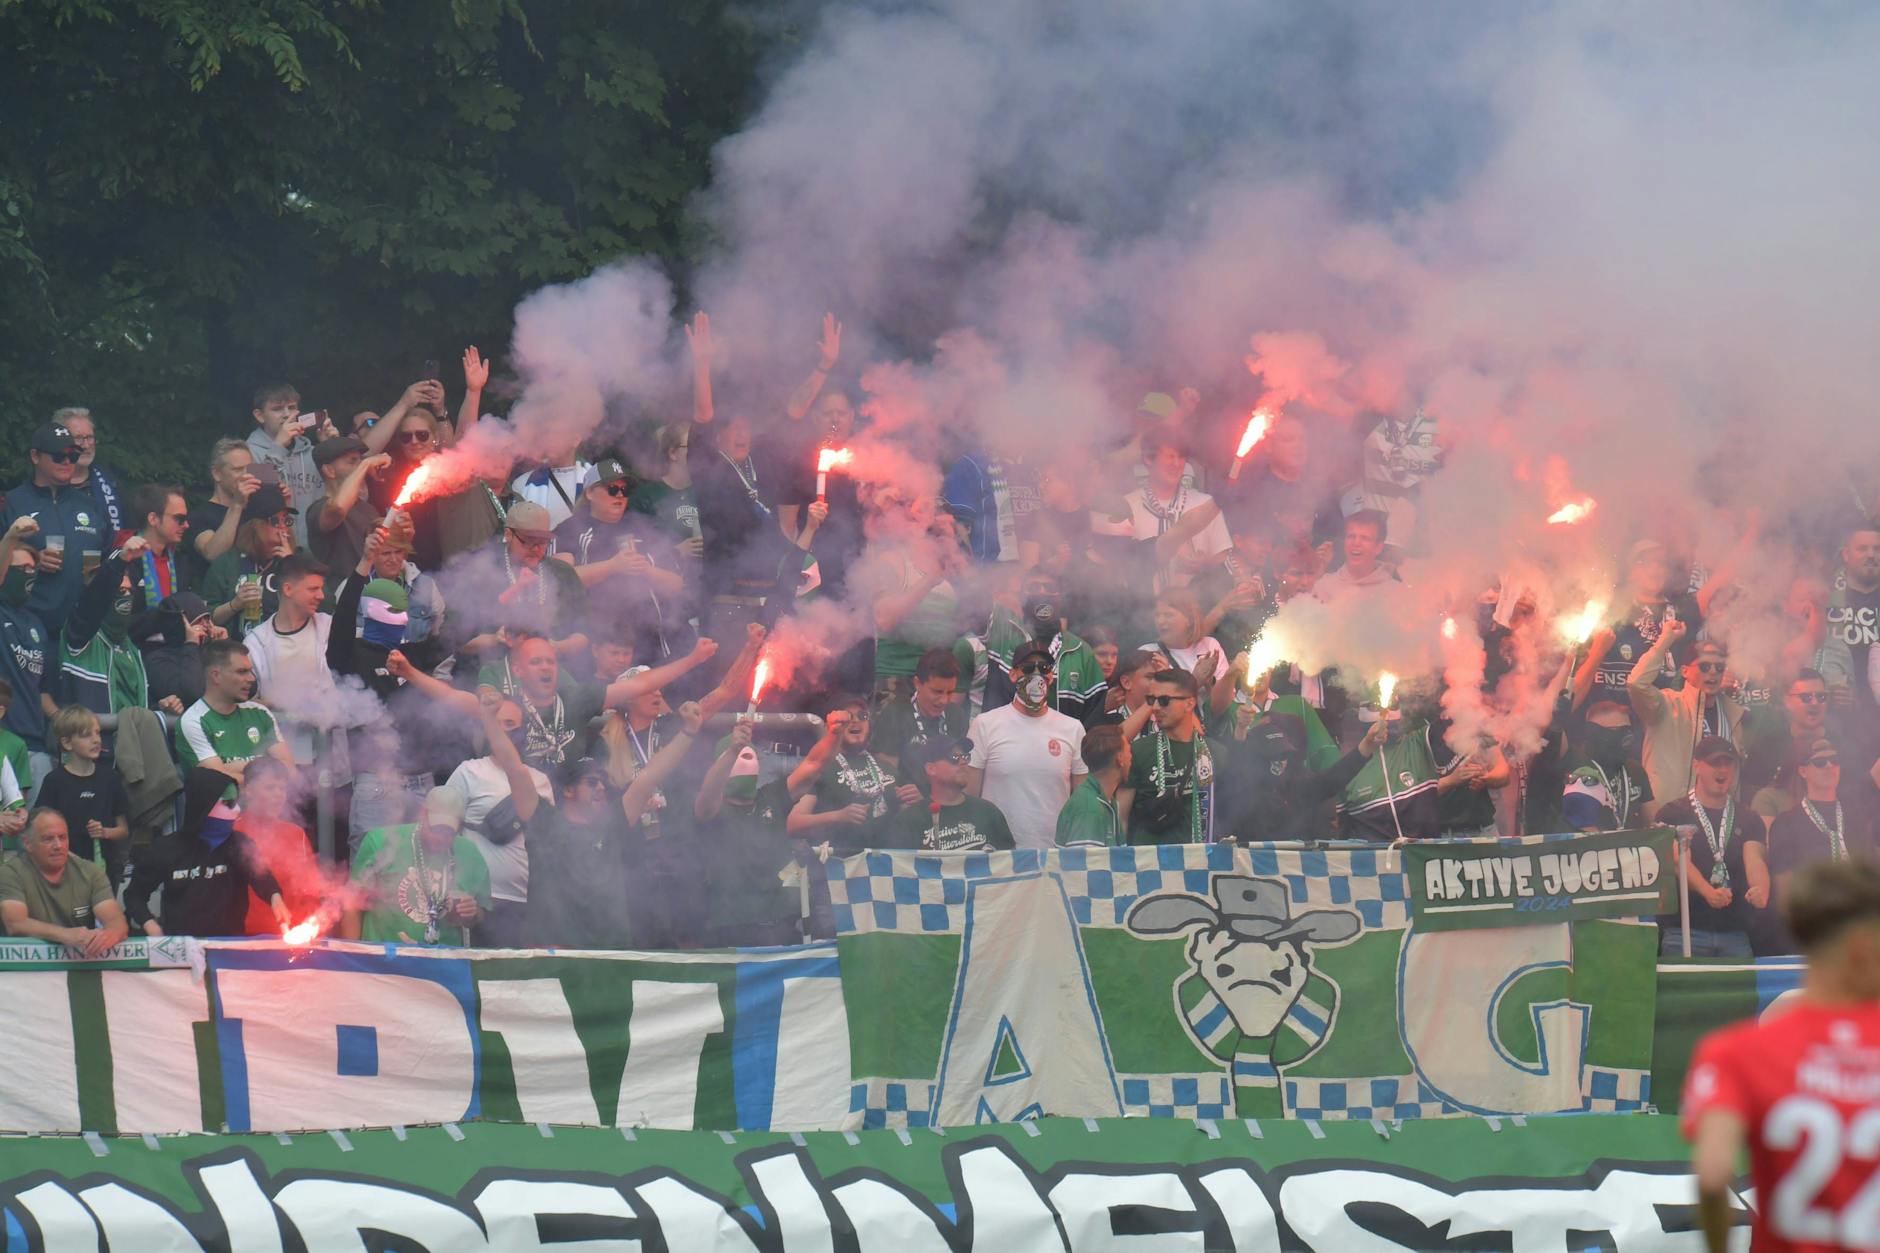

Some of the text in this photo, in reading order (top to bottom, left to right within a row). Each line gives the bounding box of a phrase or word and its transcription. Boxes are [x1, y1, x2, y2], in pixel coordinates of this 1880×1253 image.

[1425, 846, 1660, 900] AKTIVE JUGEND
[1515, 896, 1571, 913] 2024
